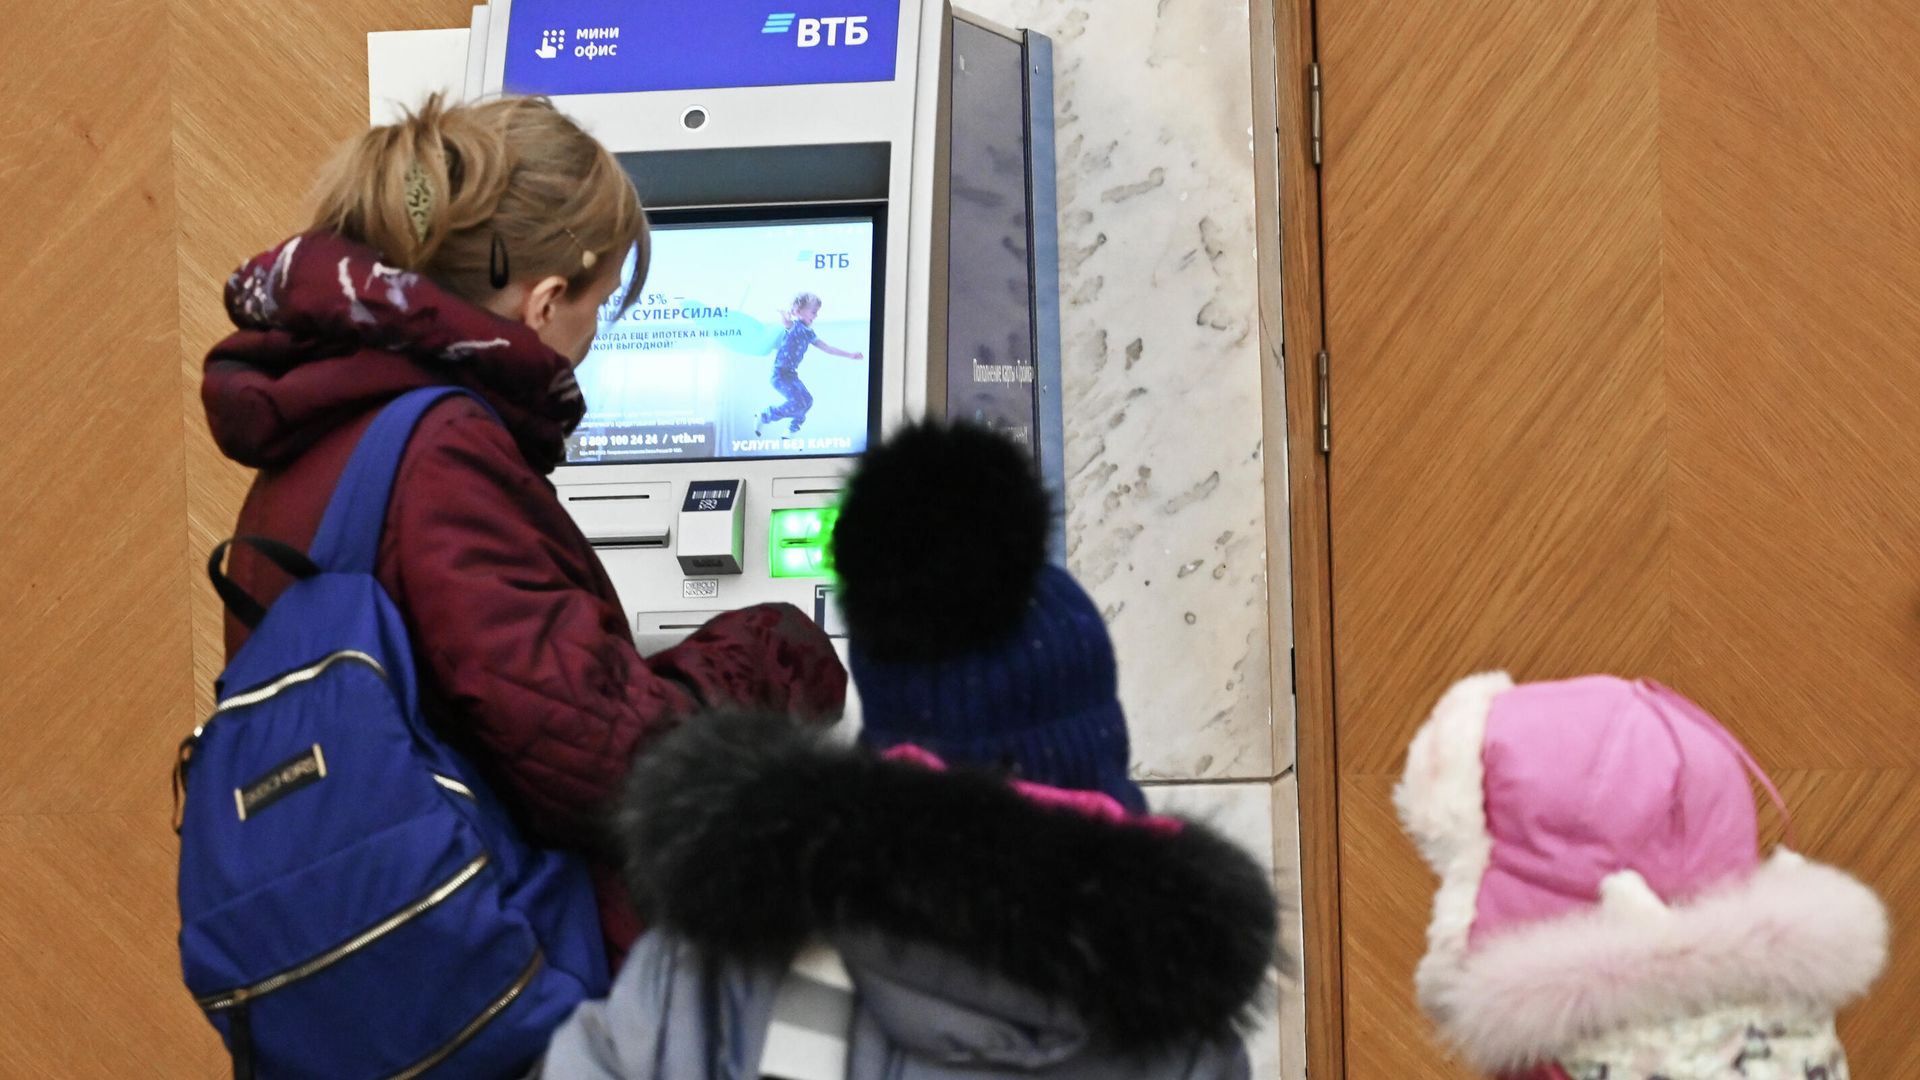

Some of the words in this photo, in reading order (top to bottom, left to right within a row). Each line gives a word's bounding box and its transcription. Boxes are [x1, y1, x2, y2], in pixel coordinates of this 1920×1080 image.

[796, 15, 869, 48] ВТБ
[814, 252, 850, 269] ВТБ
[647, 293, 668, 306] 5%
[632, 307, 729, 322] СУПЕРСИЛА!
[630, 332, 649, 341] ЕЩЕ
[652, 330, 696, 340] ИПОТЕКА
[713, 328, 743, 337] БЫЛА
[616, 339, 674, 352] ВЫГОДНОЙ!
[630, 434, 643, 446] 24
[645, 433, 658, 445] 24
[671, 431, 705, 444] vtb.ru
[732, 439, 780, 452] УСЛУГИ
[783, 438, 805, 451] БЕЗ
[808, 437, 852, 450] КАРТЫ
